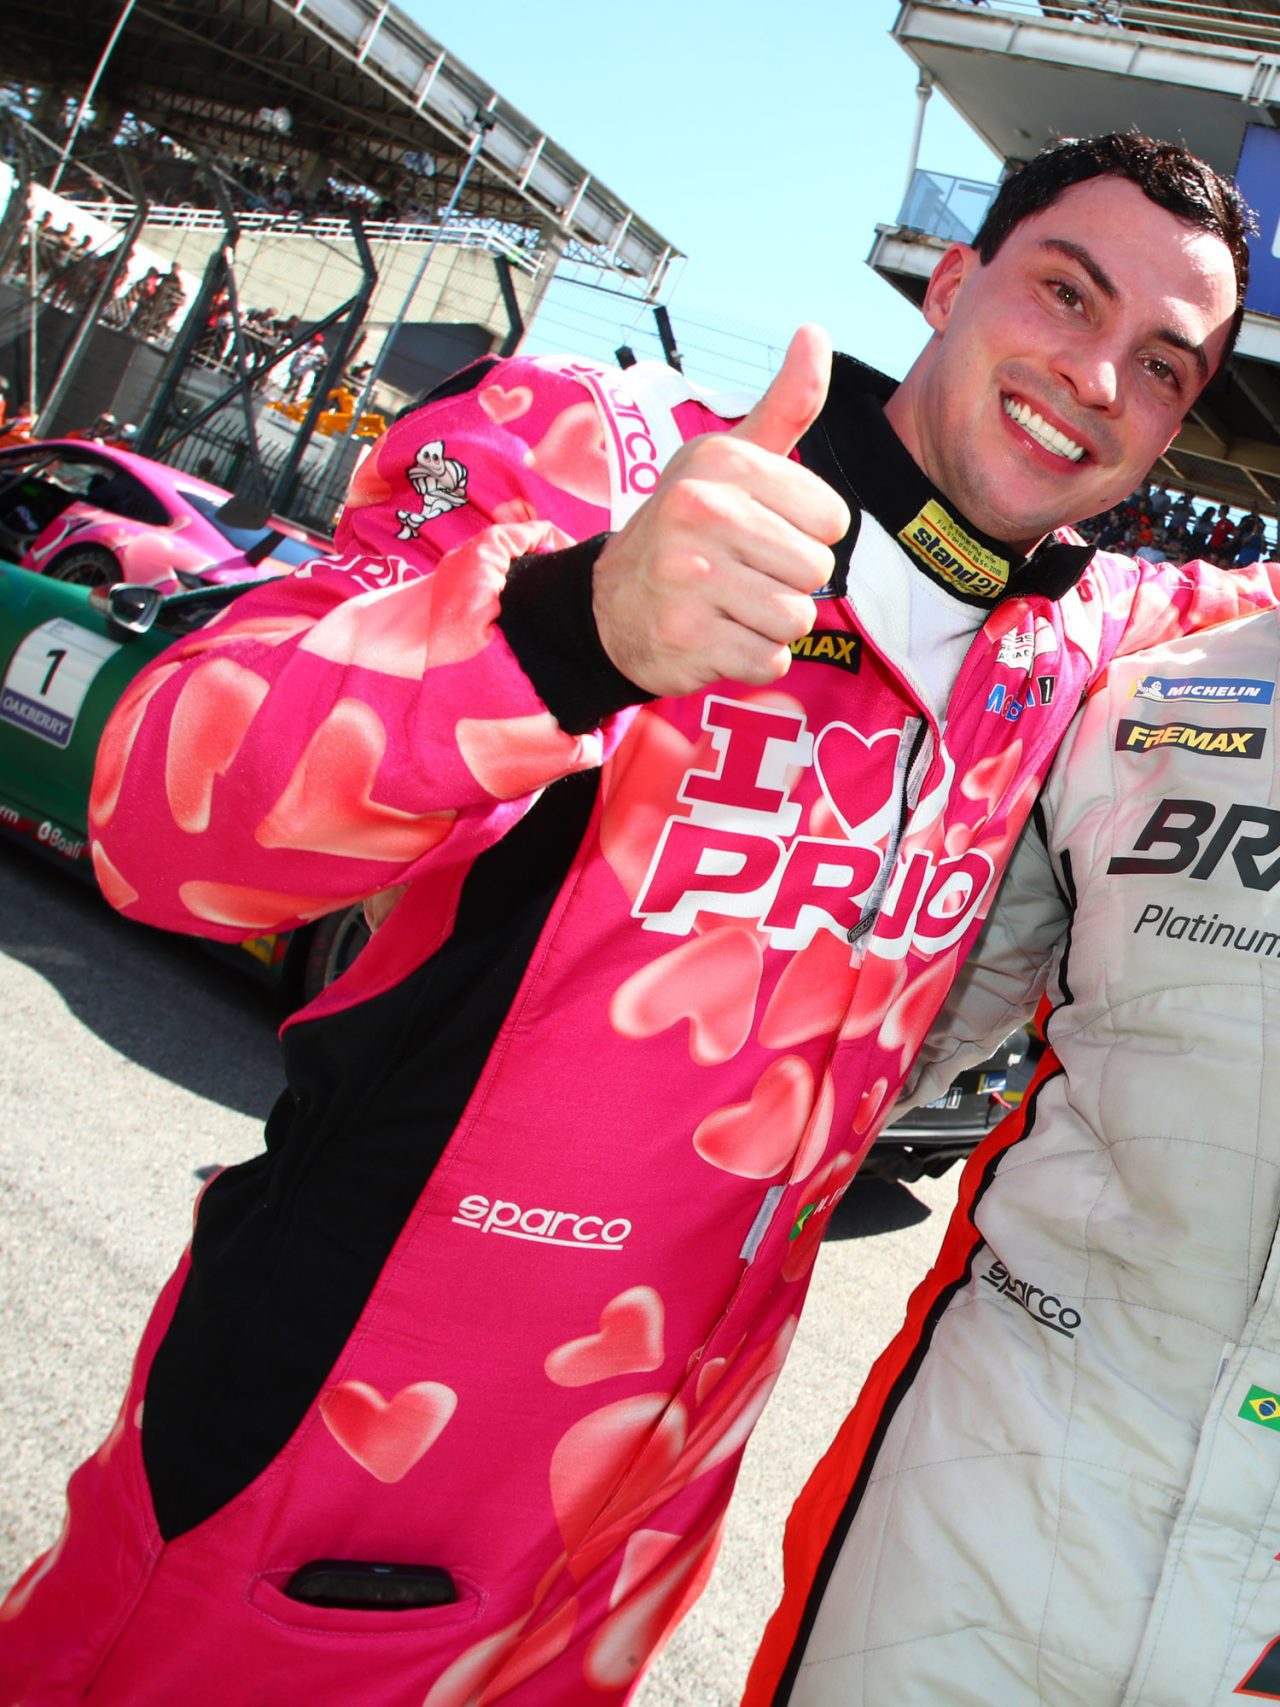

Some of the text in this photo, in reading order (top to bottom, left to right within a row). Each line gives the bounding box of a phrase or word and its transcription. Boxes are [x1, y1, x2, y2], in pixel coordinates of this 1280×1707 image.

[912, 527, 1000, 596] stand21
[40, 648, 67, 697] 1
[789, 636, 856, 665] MAX
[1167, 685, 1261, 697] MICHELIN
[3, 696, 69, 737] OAKBERRY
[1126, 726, 1253, 753] FREMAX
[678, 695, 806, 820] I
[632, 816, 994, 955] PRIO
[458, 1194, 632, 1243] sparco
